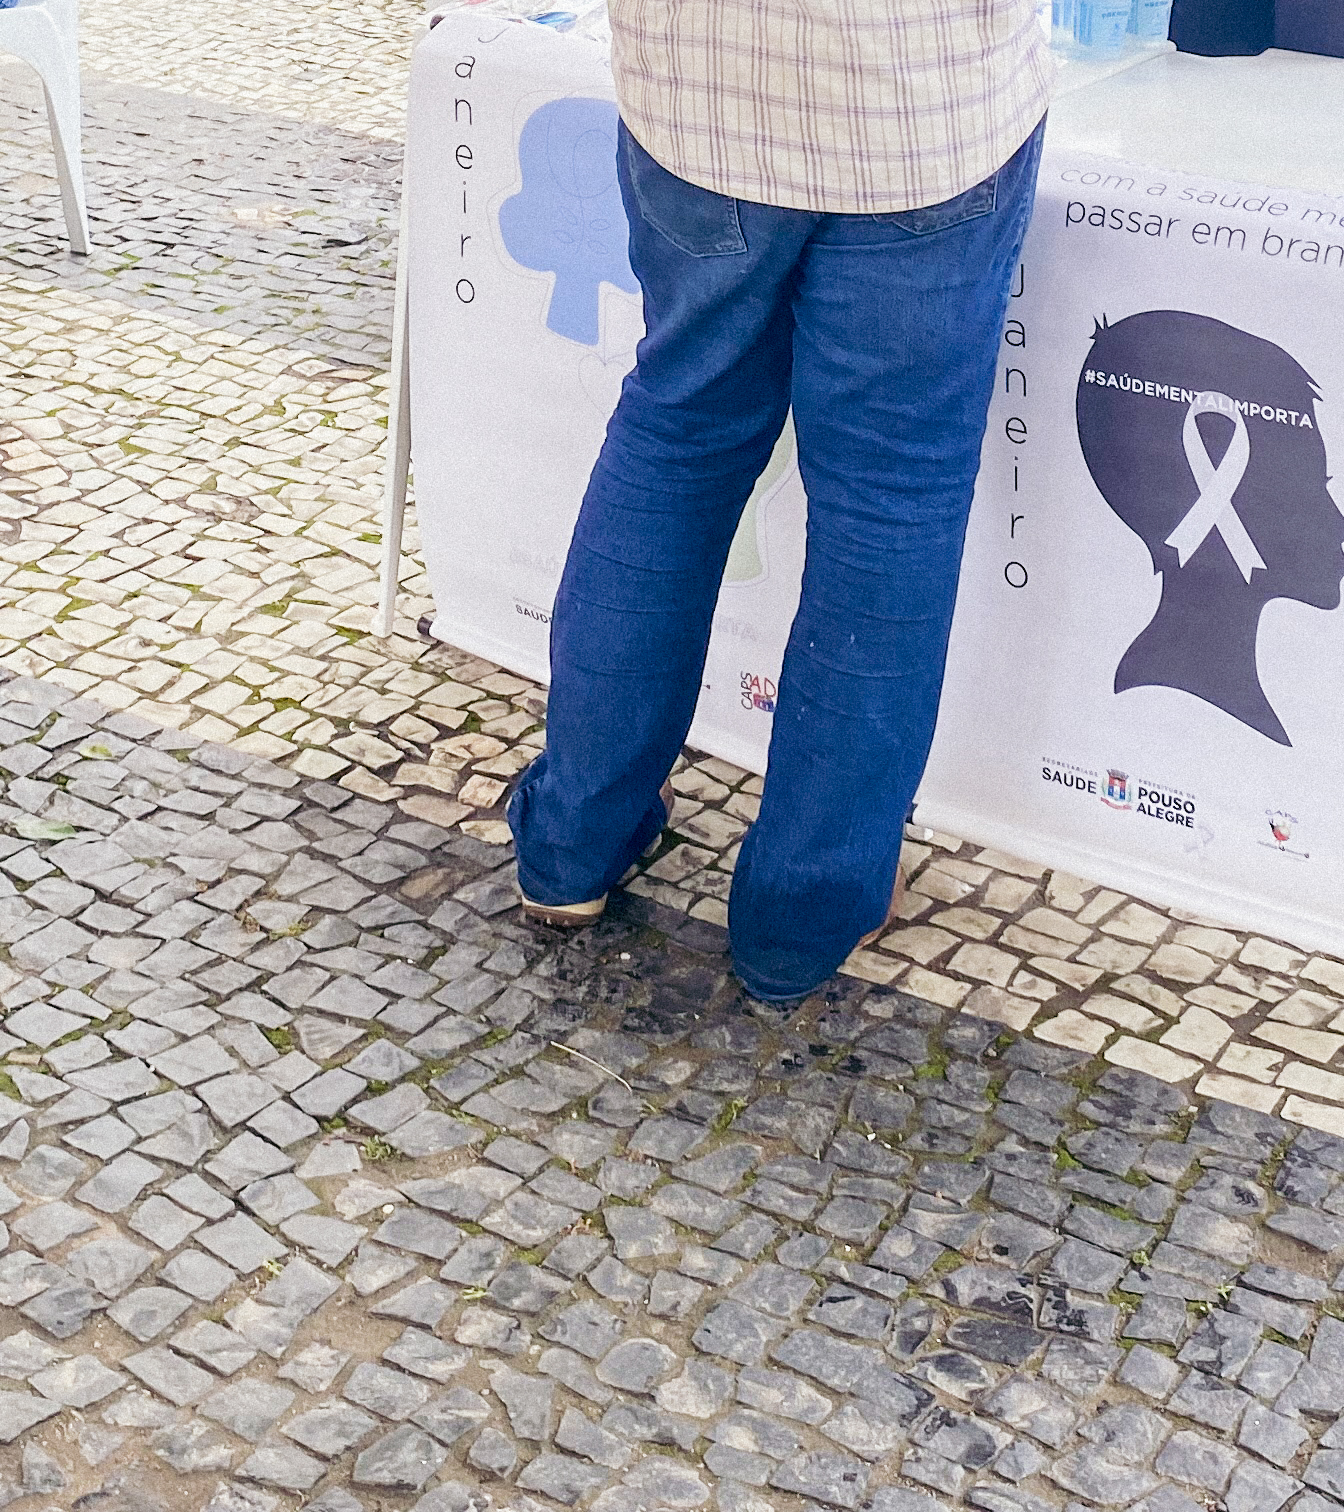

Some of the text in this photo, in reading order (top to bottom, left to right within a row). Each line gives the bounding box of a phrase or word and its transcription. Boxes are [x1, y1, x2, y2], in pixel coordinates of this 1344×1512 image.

[1060, 168, 1136, 191] com
[1145, 181, 1168, 197] a
[1178, 186, 1290, 217] saúde
[1064, 199, 1181, 239] passar
[1191, 221, 1246, 252] em
[1084, 368, 1314, 430] #SAÚDEMENTALIMPORTA
[740, 670, 753, 711] CAPS
[1042, 767, 1097, 795] SAÚDE
[1137, 786, 1196, 814] POUSO
[1136, 802, 1195, 829] ALEGRE
